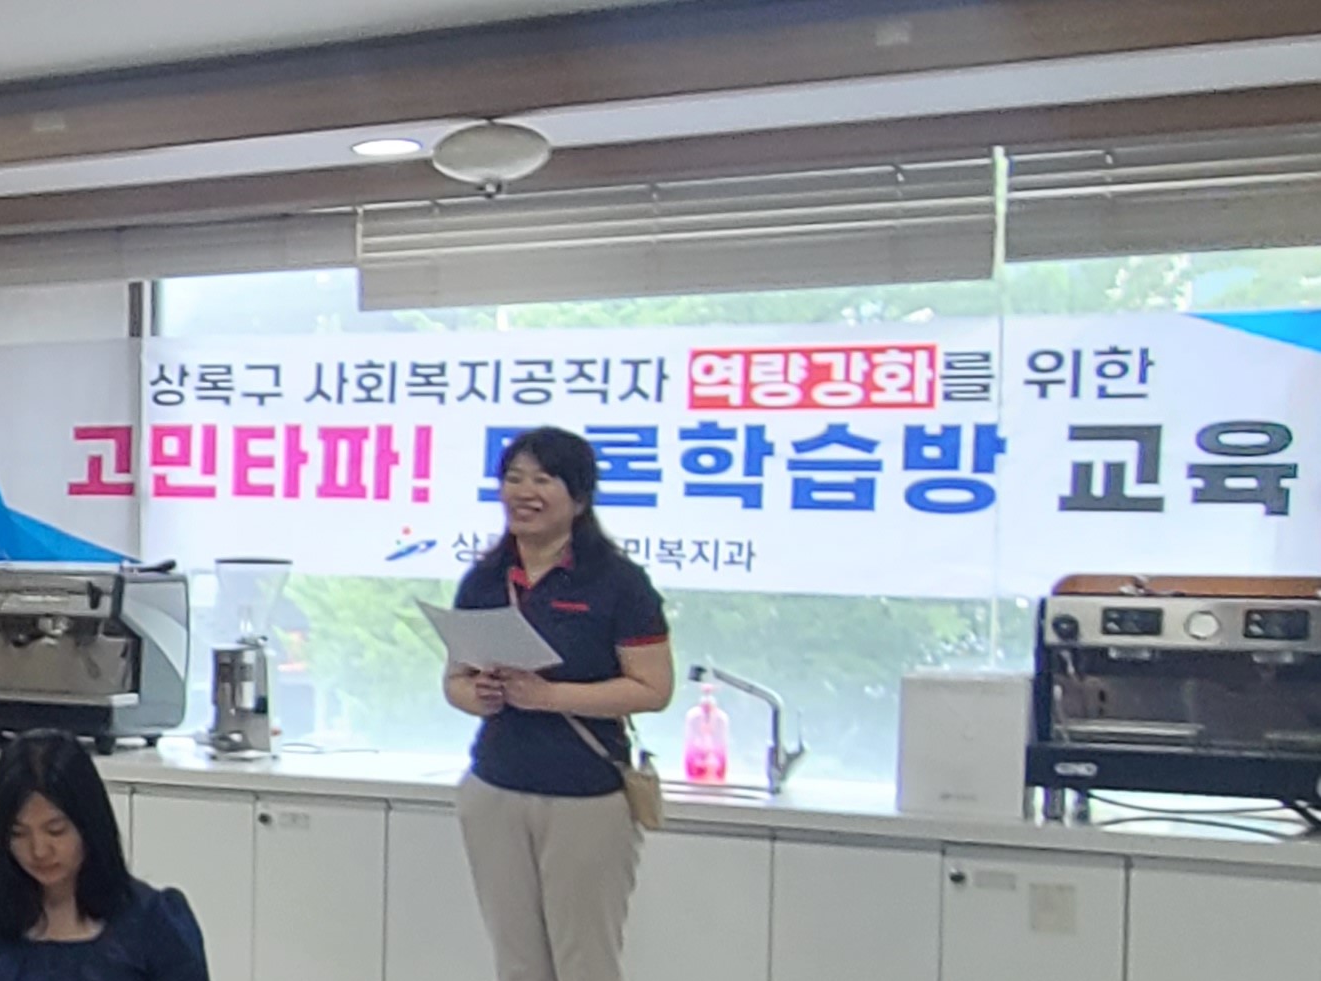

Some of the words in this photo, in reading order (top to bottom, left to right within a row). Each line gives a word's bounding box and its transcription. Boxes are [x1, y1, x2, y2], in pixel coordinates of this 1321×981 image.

[149, 362, 283, 406] 상록구
[304, 357, 669, 405] 사회복지공직자
[690, 346, 996, 408] 역량강화를
[1024, 344, 1155, 400] 위한
[67, 424, 433, 503] 고민타파!
[1057, 419, 1299, 516] 교육
